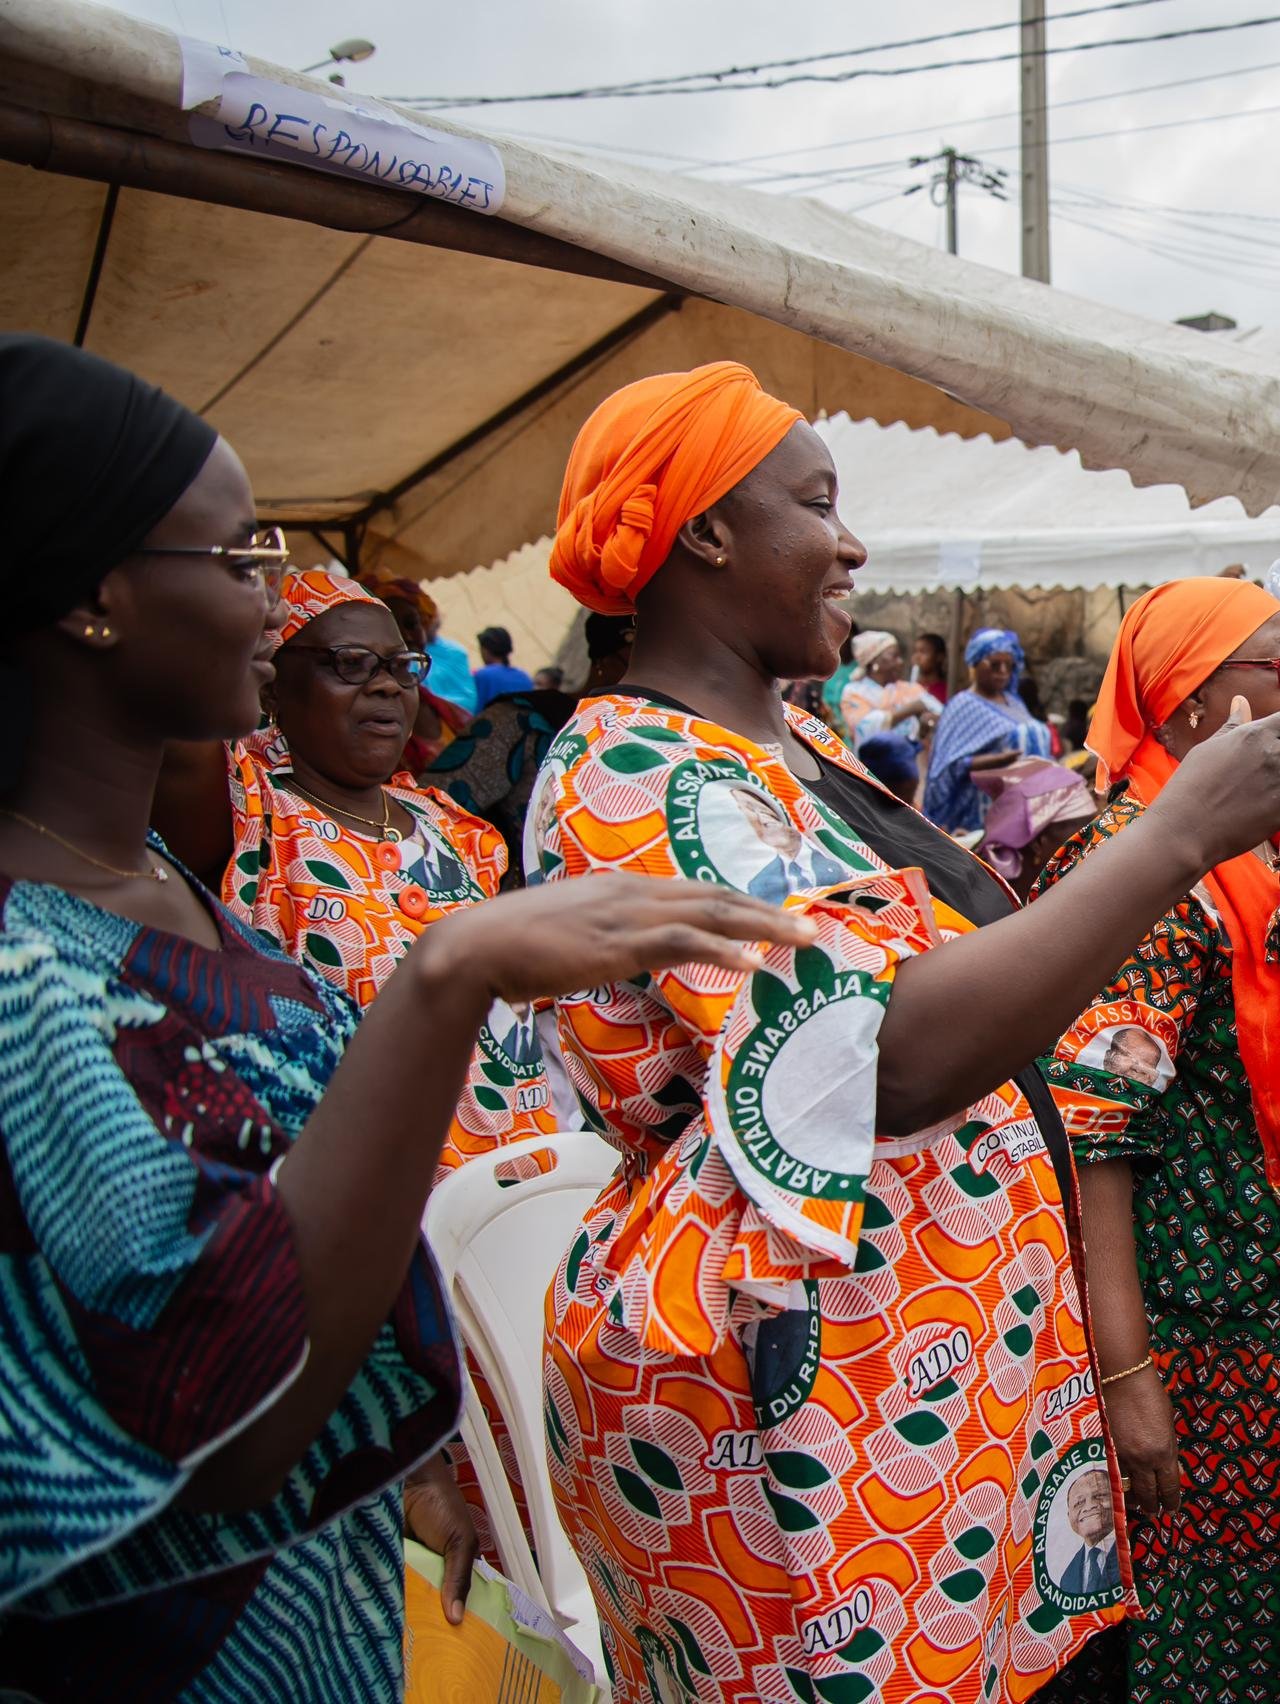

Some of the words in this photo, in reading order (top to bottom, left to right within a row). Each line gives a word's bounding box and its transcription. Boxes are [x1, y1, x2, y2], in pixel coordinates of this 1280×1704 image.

[225, 102, 495, 208] RESPONSABLES
[302, 818, 339, 842] DO
[307, 896, 345, 921] DO
[1075, 1003, 1169, 1044] ALASSANE
[977, 1120, 1039, 1163] CONTINUI
[1011, 1136, 1046, 1163] STABIL
[768, 1384, 803, 1419] DU
[799, 1290, 819, 1384] RHDP
[911, 1330, 970, 1395] ADO
[709, 1433, 765, 1468] AD
[1034, 1449, 1084, 1553] ALASSANE
[1038, 1575, 1110, 1611] CANDIDAT
[803, 1589, 872, 1655] ADO
